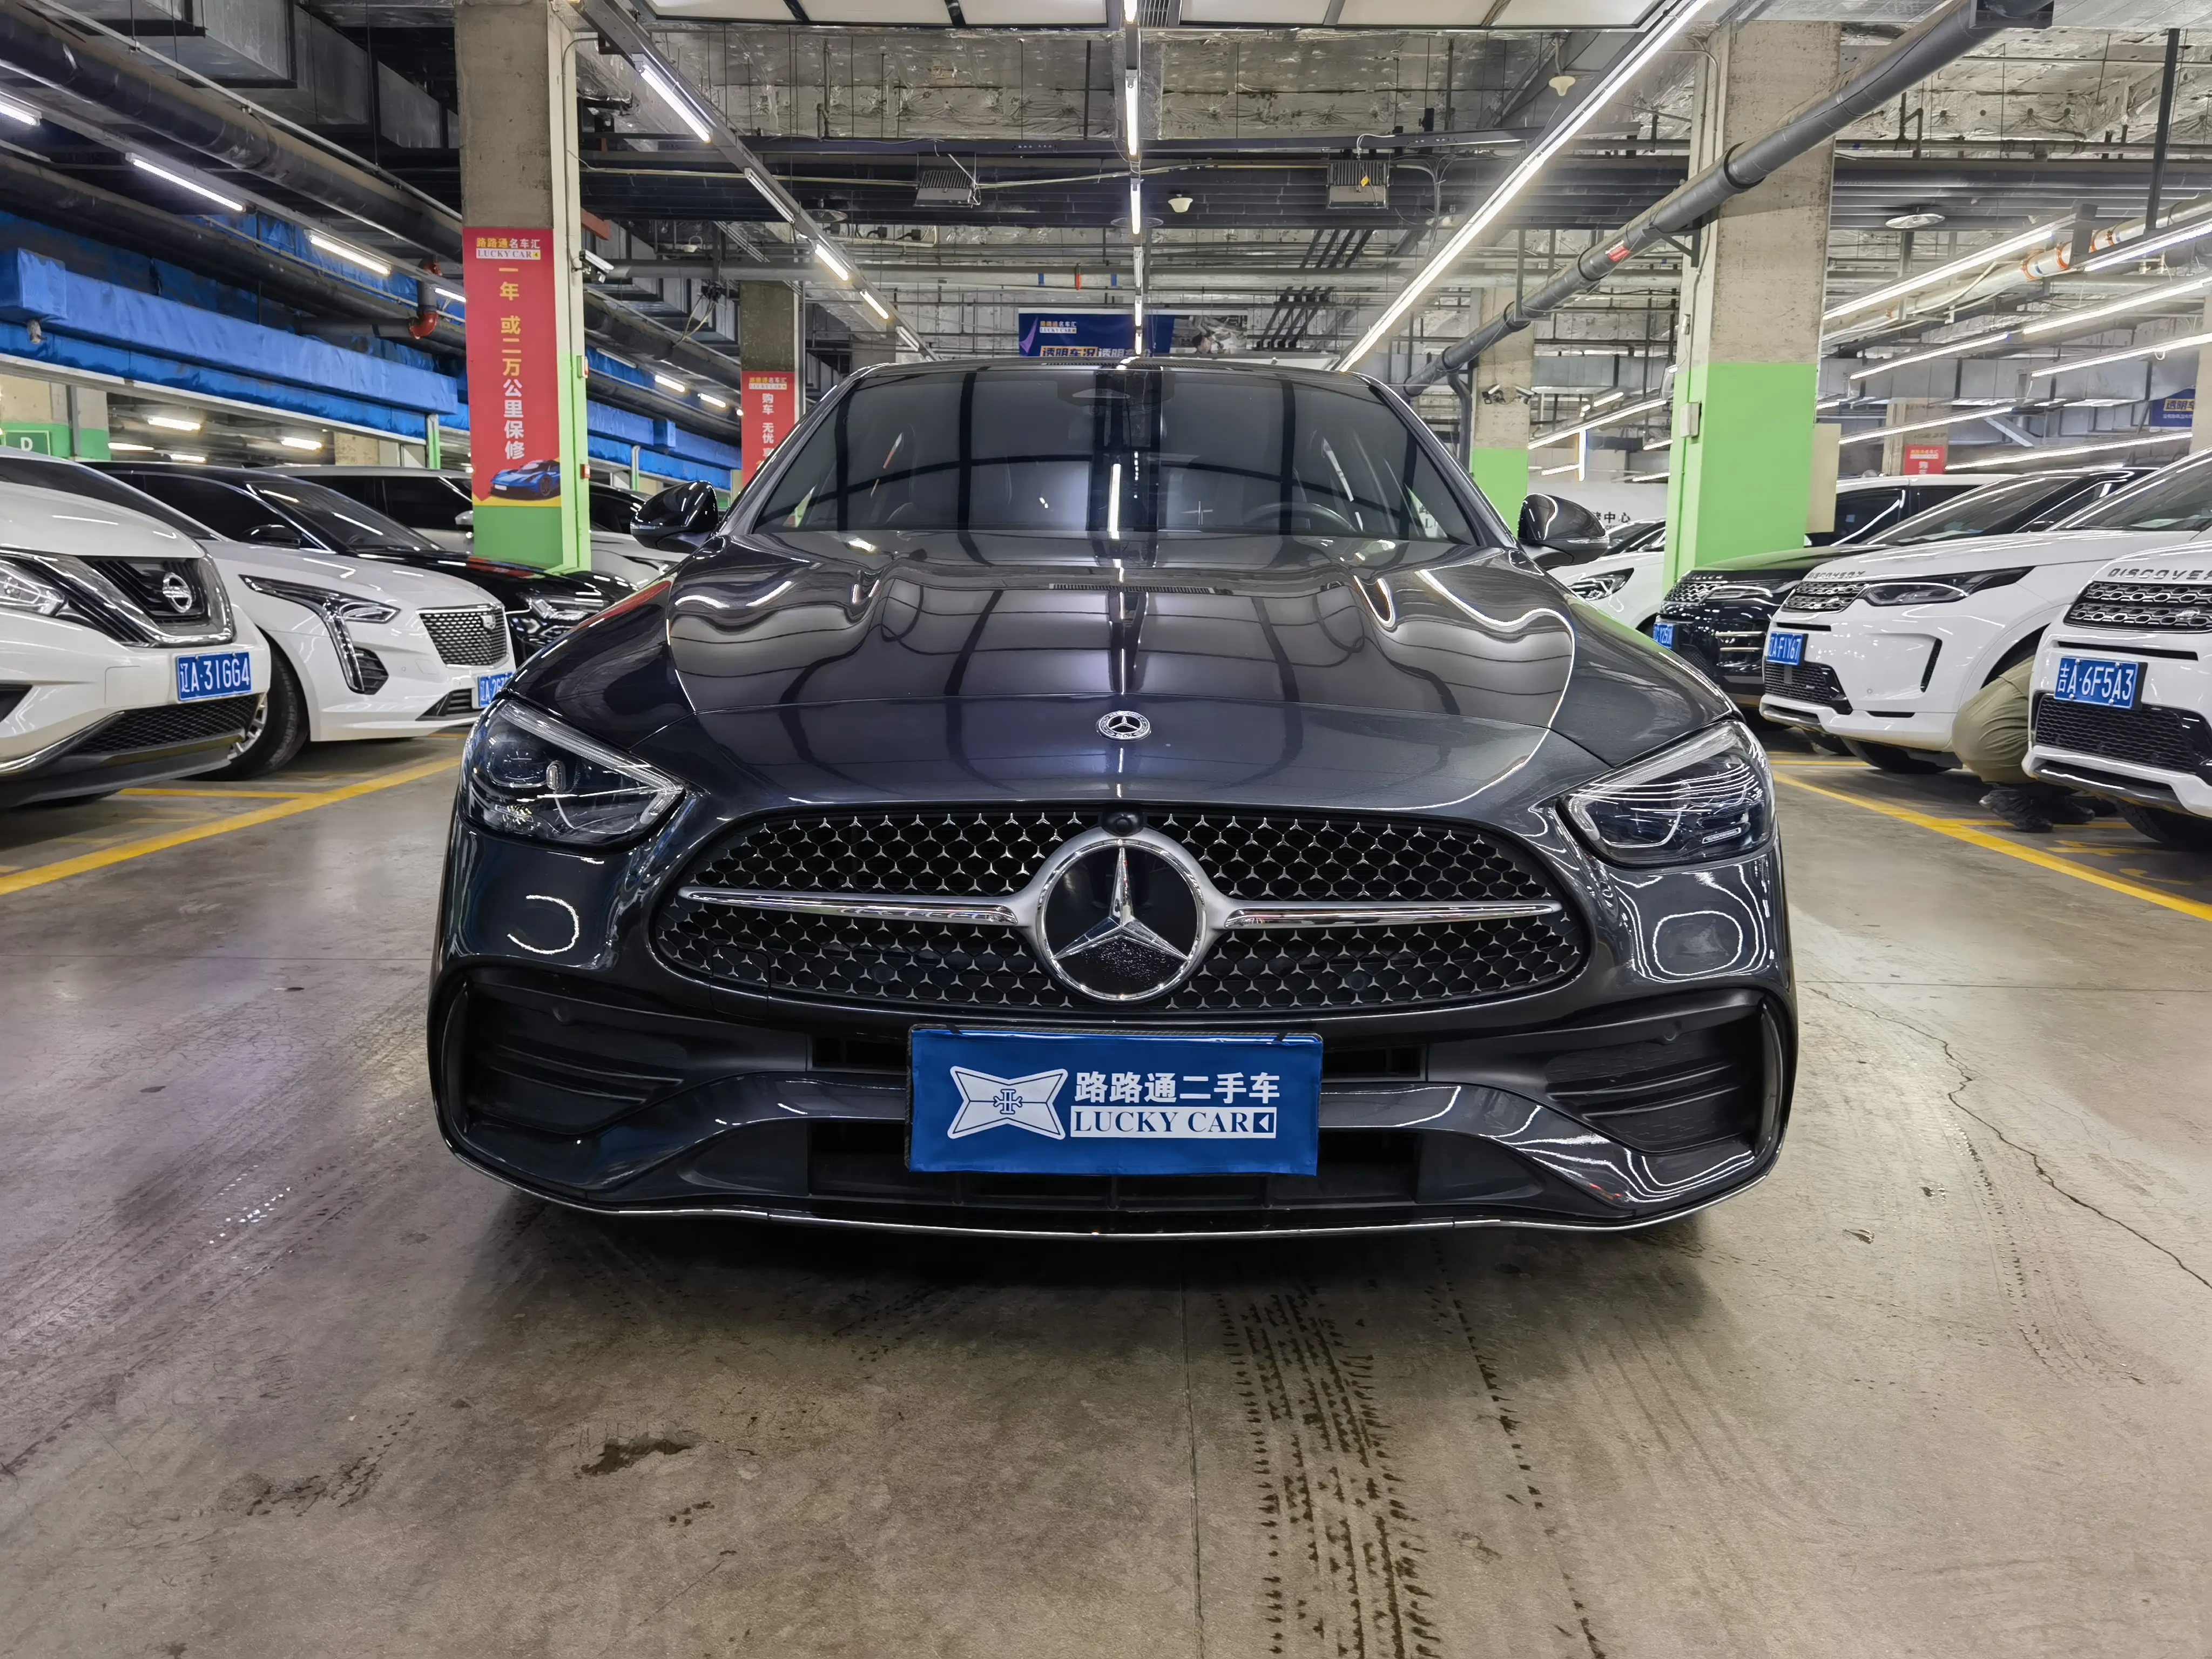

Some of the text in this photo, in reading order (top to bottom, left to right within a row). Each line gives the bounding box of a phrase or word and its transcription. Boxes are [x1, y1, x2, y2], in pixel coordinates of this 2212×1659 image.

[476, 237, 541, 248] 路路通名车汇
[477, 249, 510, 258] LUCKY
[20, 437, 33, 451] D
[1075, 1071, 1280, 1104] 路路通二手车
[1074, 1111, 1249, 1132] LUCKY CAR
